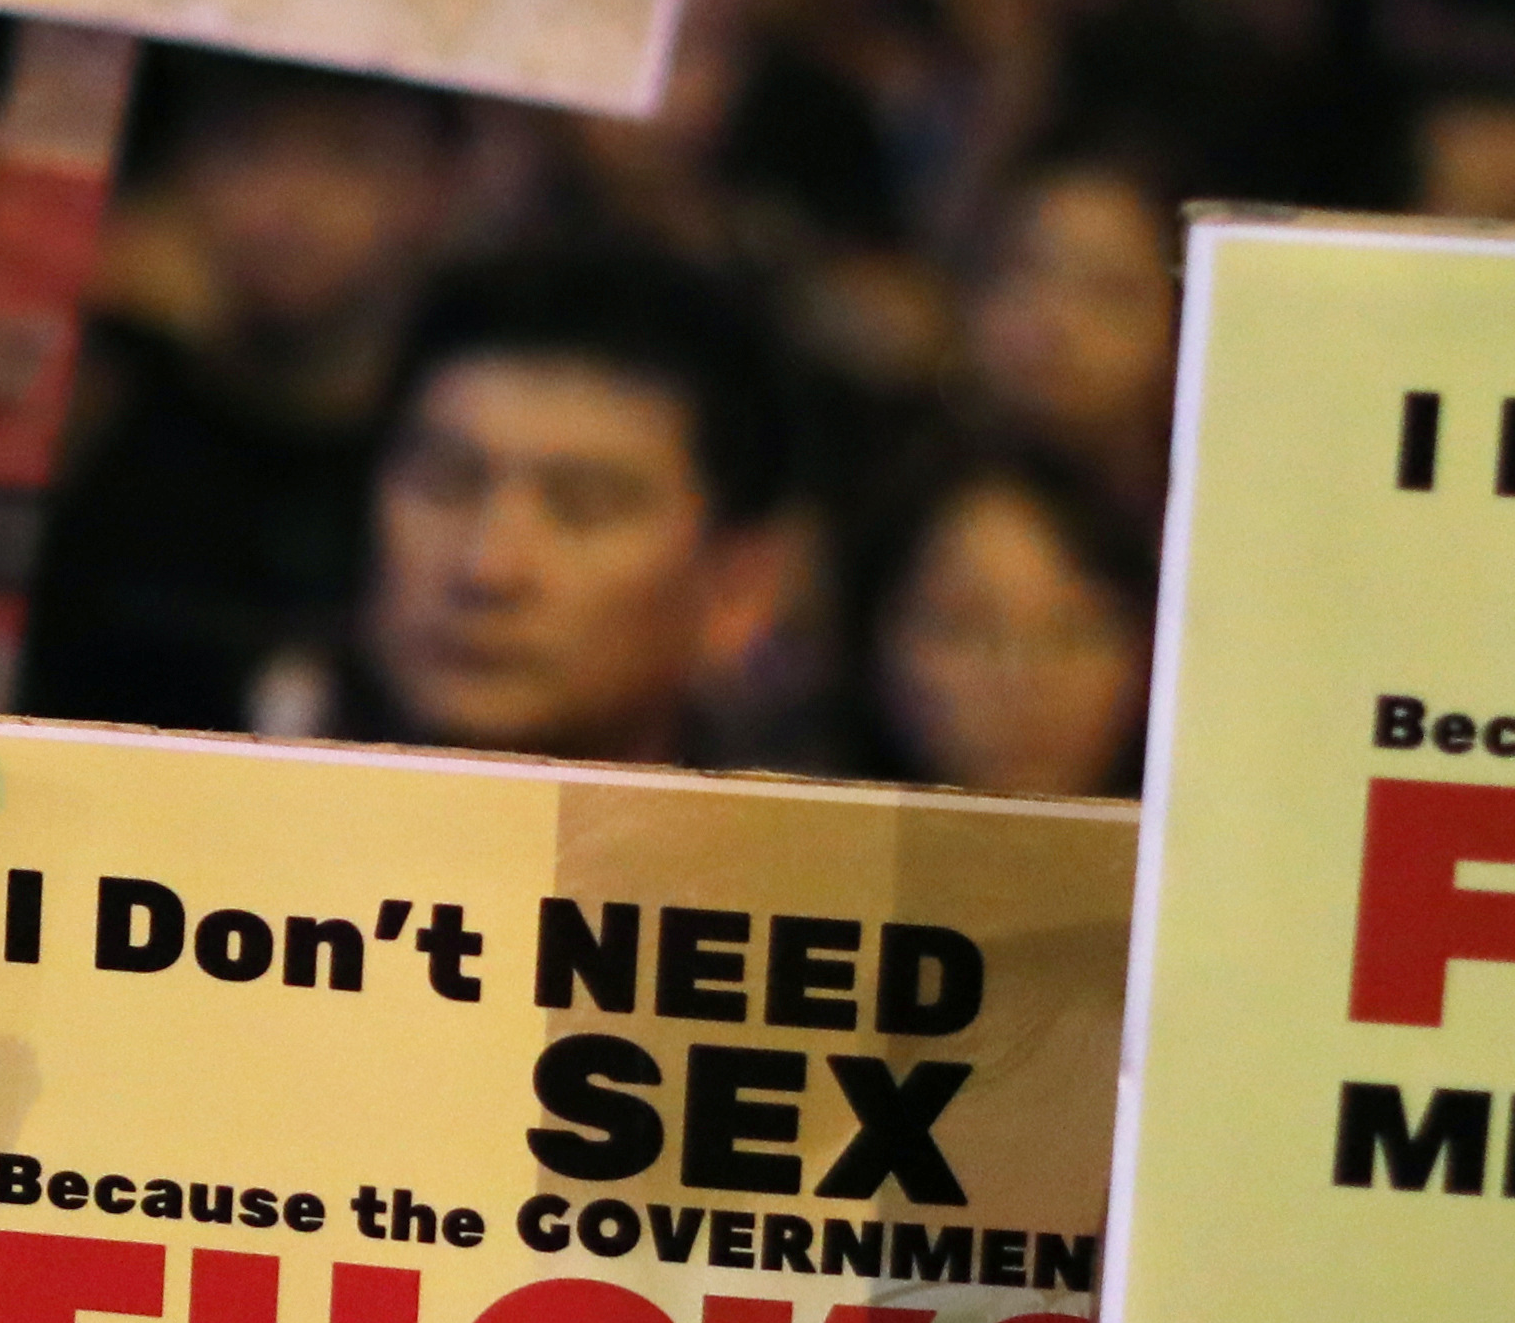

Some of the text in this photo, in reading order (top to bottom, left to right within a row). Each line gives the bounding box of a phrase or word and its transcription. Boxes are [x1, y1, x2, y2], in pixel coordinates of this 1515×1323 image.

[1400, 393, 1439, 490] I
[6, 870, 989, 1044] I Don't NEED
[529, 1034, 975, 1207] SEX
[353, 1188, 484, 1247] the
[519, 1195, 1098, 1294] GOVERNMEN
